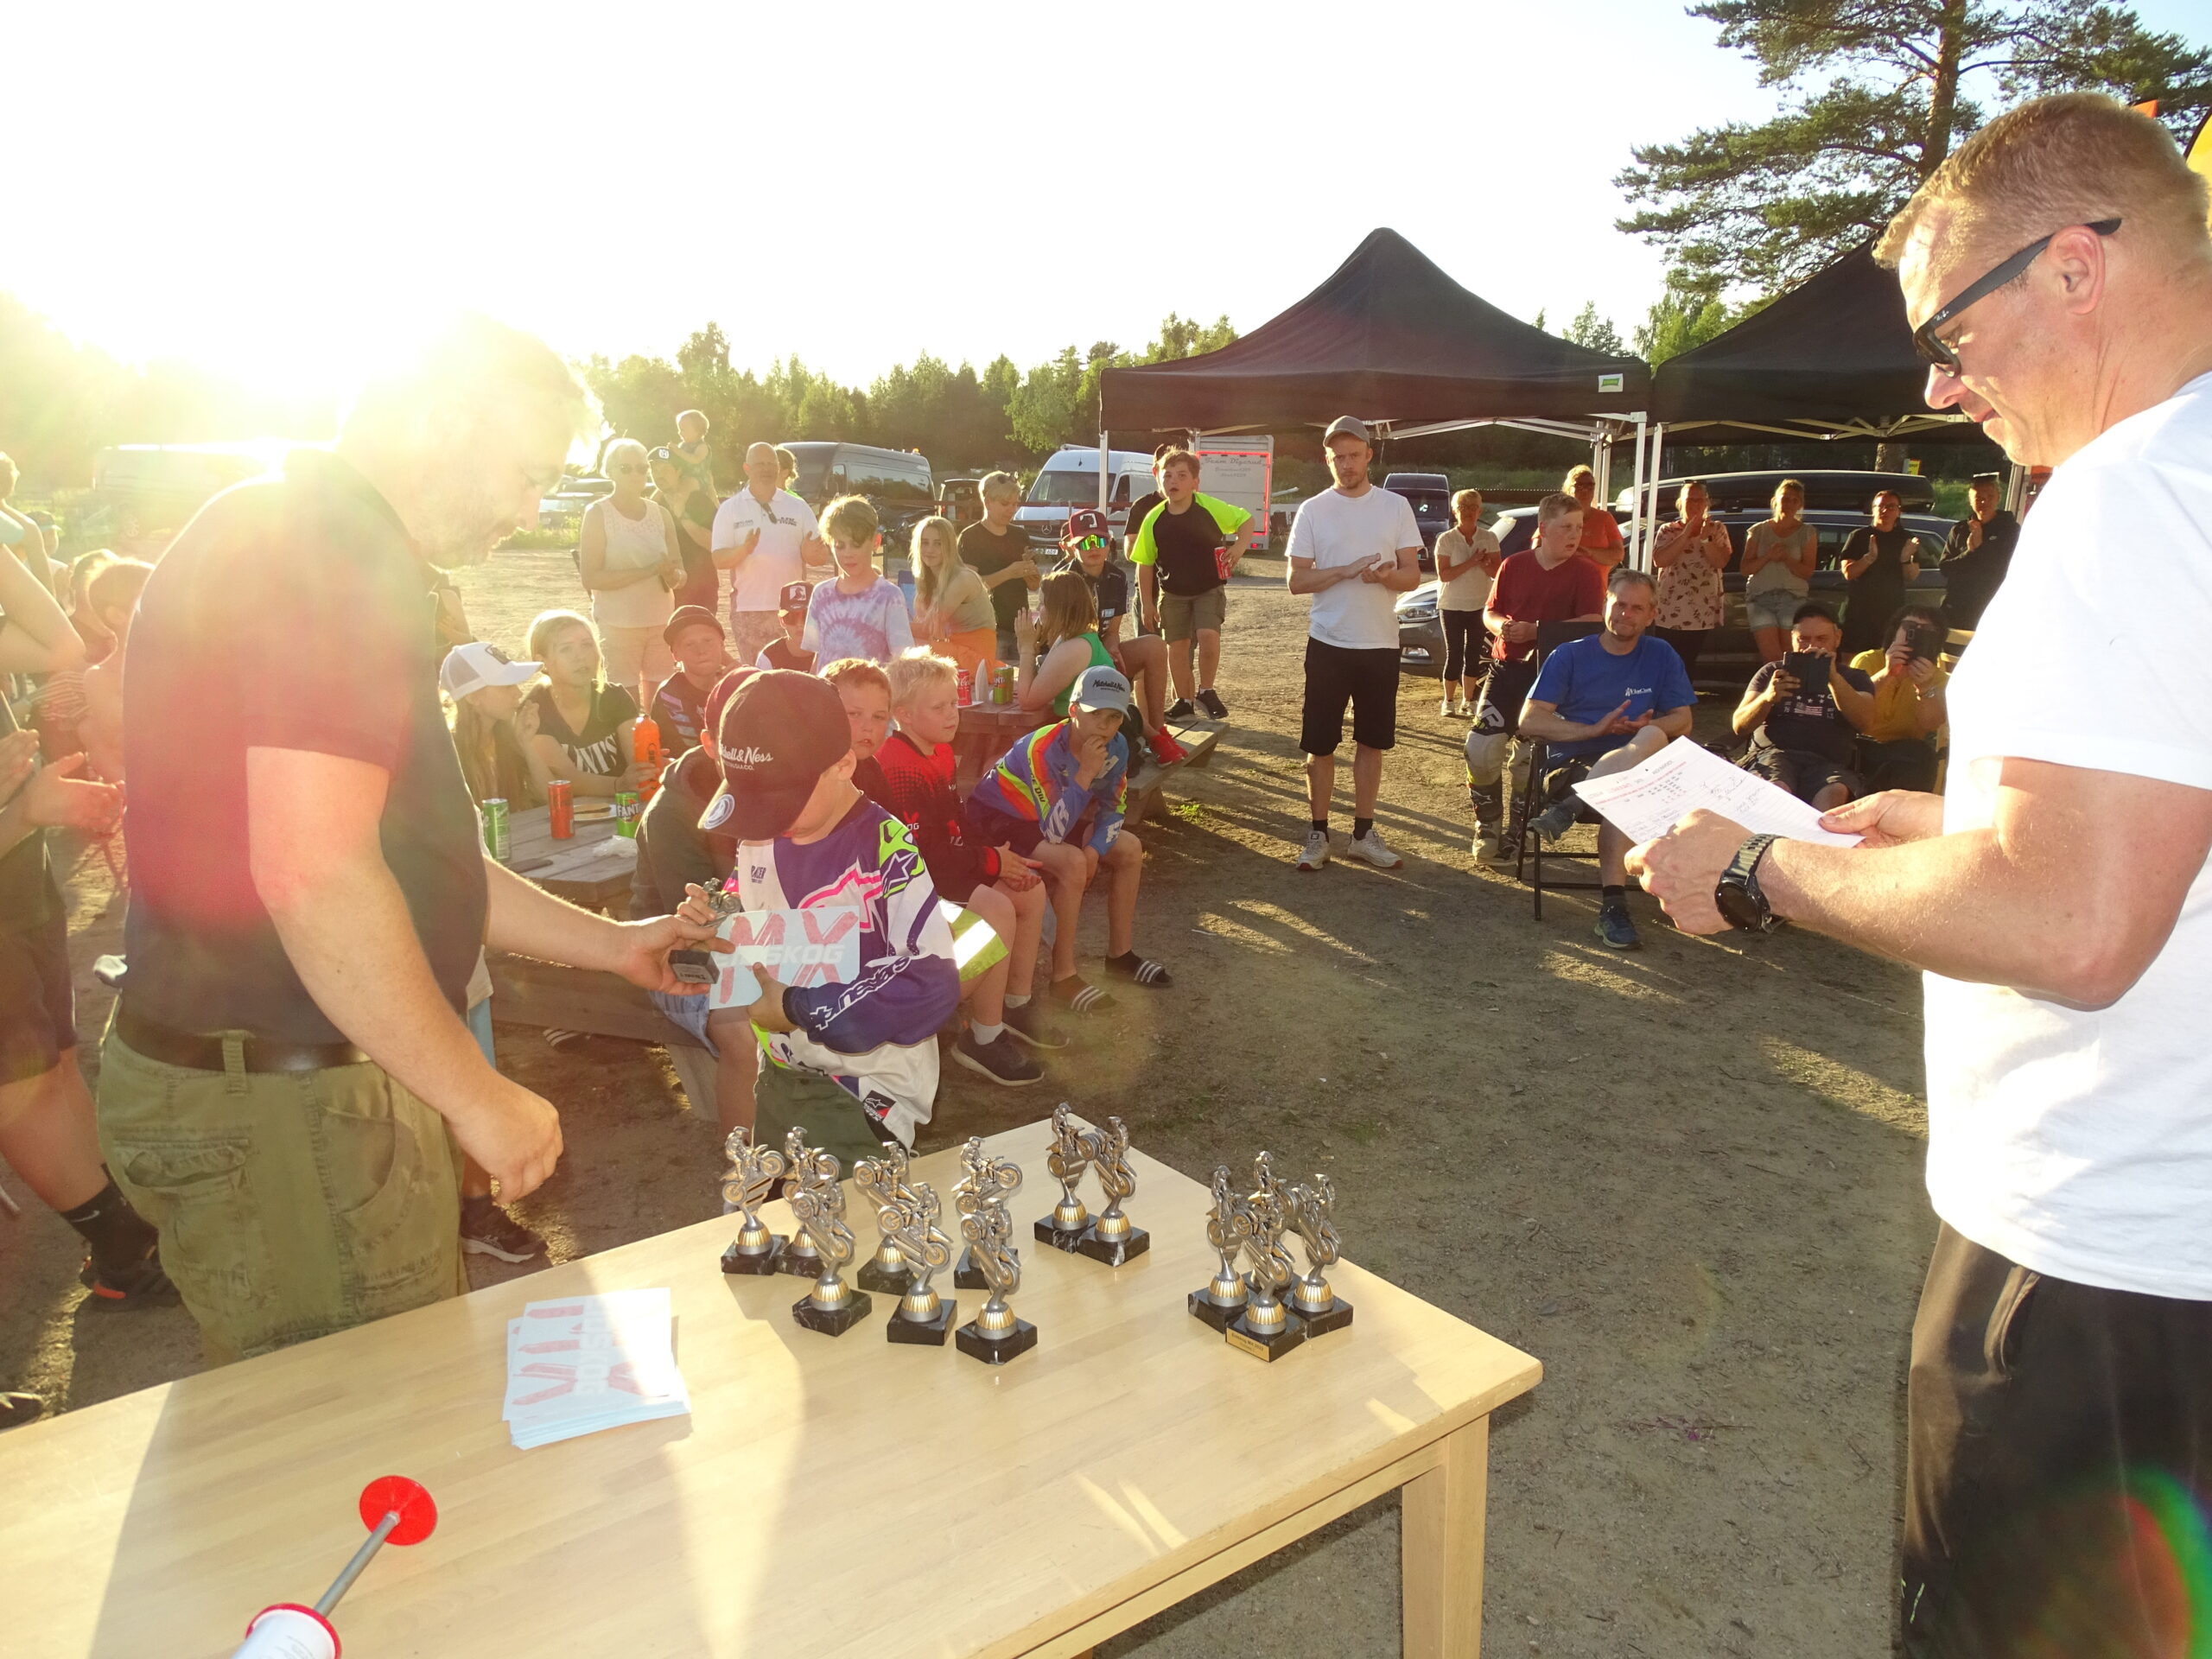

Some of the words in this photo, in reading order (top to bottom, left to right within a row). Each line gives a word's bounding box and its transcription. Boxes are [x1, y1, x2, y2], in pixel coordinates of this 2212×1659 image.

[744, 747, 773, 765] Ness
[617, 803, 640, 818] FANT
[719, 910, 859, 1005] MX
